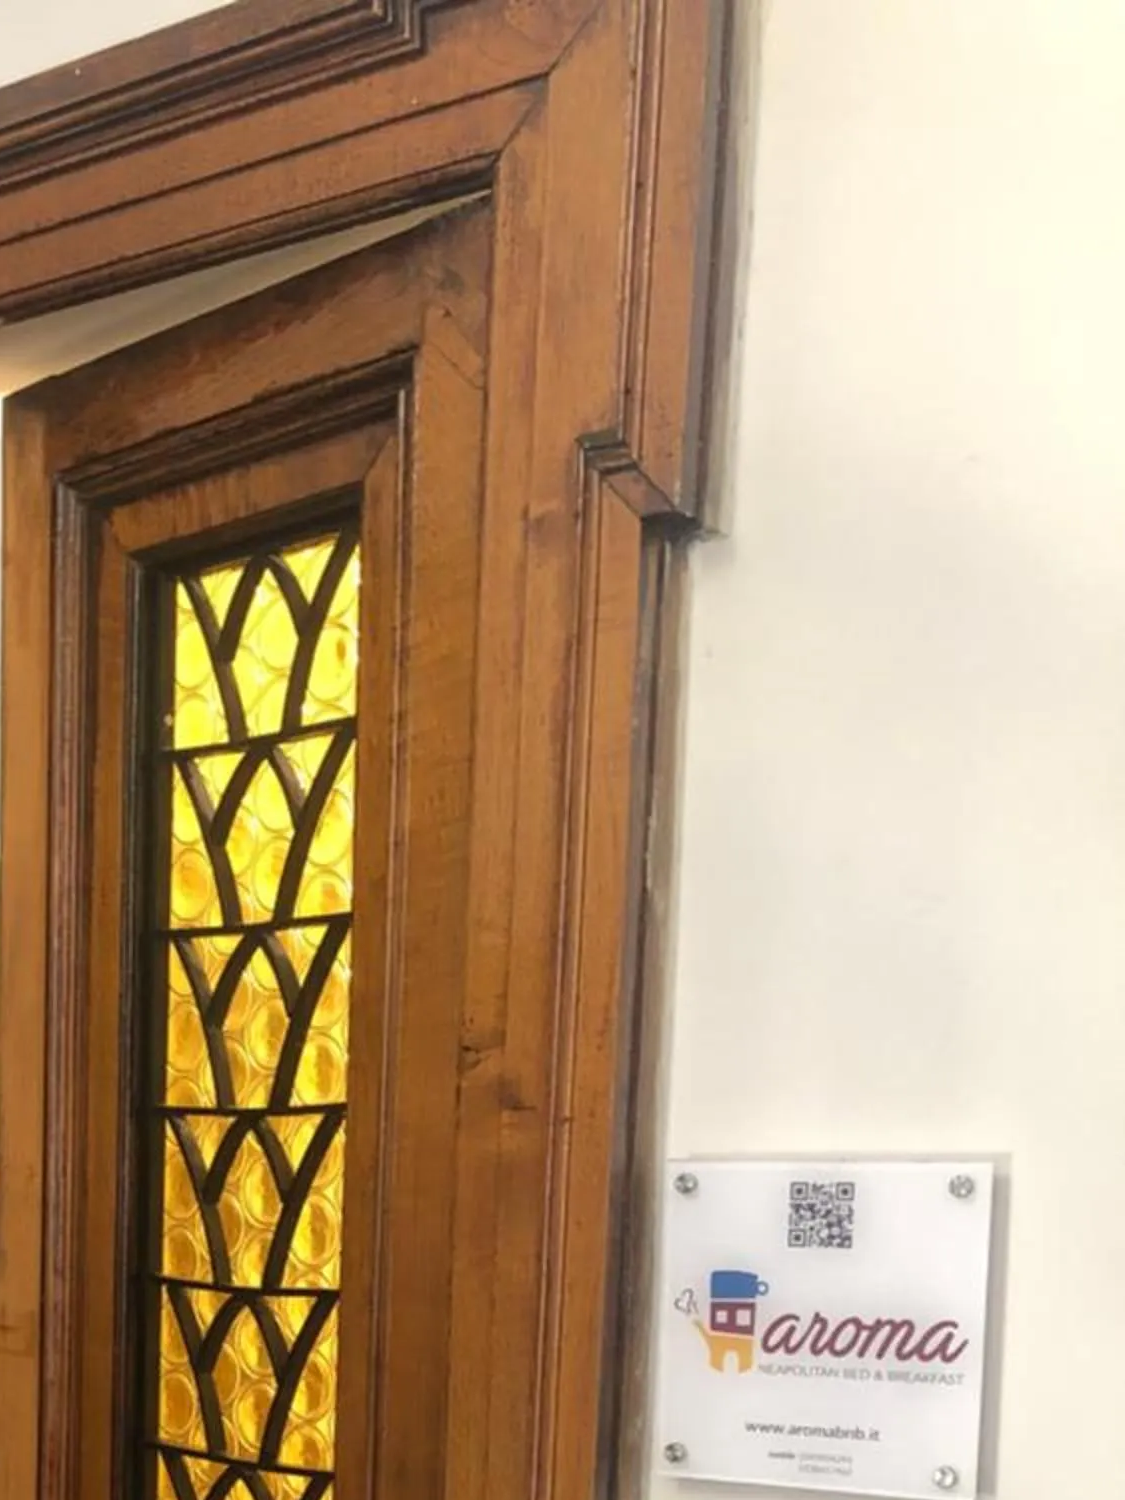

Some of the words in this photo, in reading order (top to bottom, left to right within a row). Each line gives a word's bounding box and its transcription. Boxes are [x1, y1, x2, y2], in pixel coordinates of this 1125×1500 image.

[761, 1311, 969, 1364] aroma
[759, 1363, 839, 1378] NEAPOLITAN
[843, 1368, 871, 1381] BED
[874, 1369, 884, 1382] &
[887, 1370, 966, 1386] BREAKFAST
[745, 1421, 881, 1442] www.aromabnb.it
